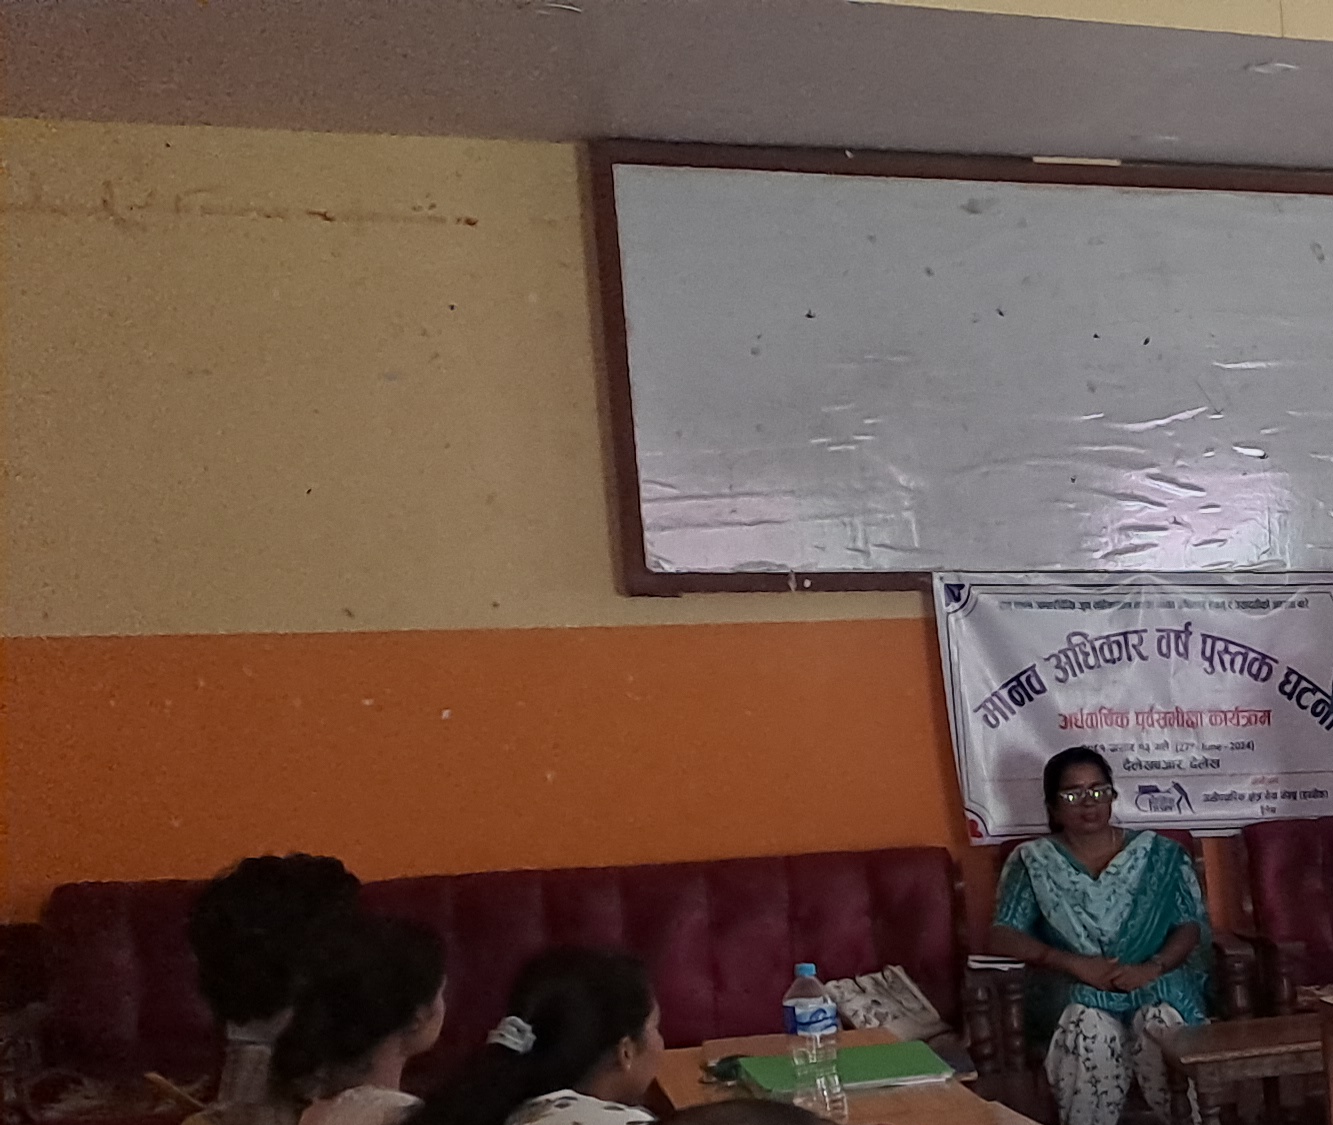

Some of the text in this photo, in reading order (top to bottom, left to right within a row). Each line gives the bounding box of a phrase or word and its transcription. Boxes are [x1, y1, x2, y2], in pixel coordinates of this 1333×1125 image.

[973, 664, 1047, 729] मानव
[1044, 629, 1149, 683] अधिकार
[1155, 621, 1193, 660] वर्ष
[1200, 633, 1279, 683] पुस्तक
